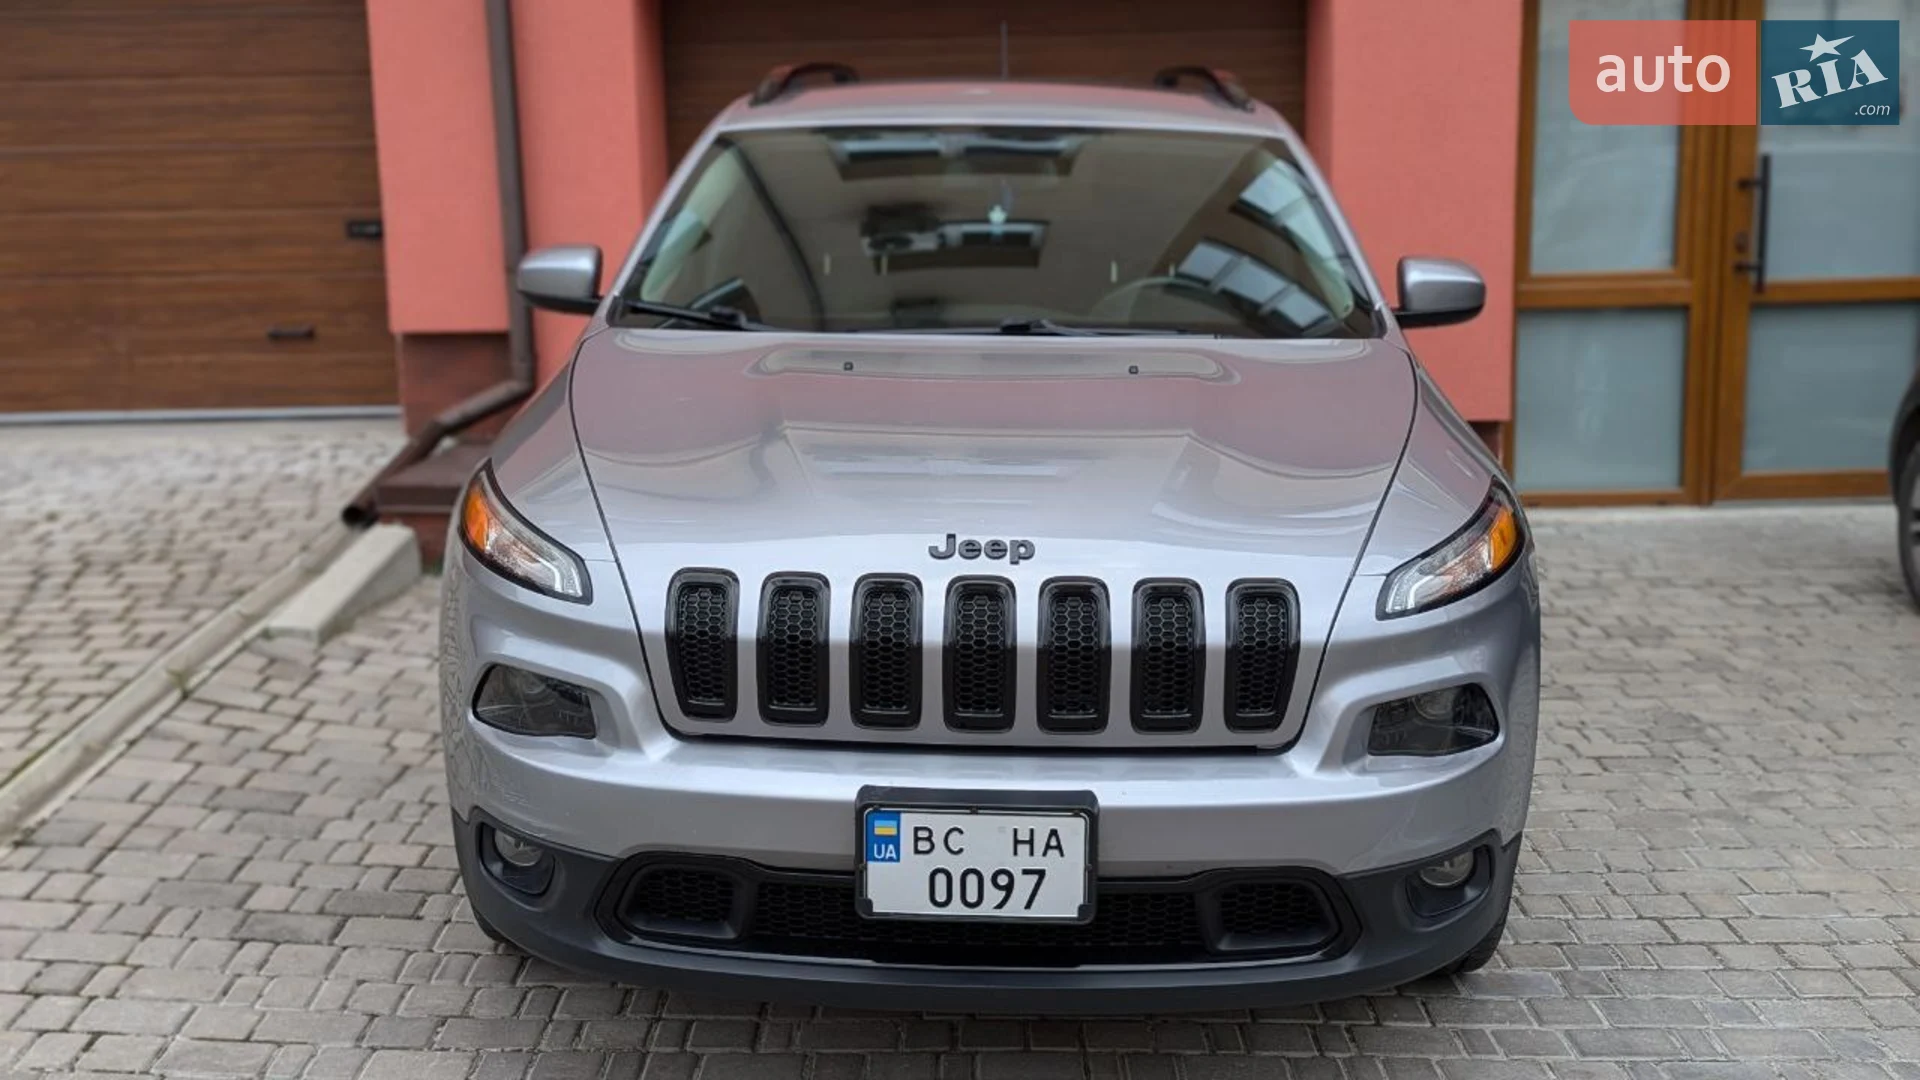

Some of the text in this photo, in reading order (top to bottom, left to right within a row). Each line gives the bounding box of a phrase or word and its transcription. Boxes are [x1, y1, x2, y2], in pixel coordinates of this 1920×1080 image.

[928, 533, 1036, 565] Jeep
[873, 843, 897, 860] UA
[913, 826, 1065, 858] BC HA
[928, 867, 1047, 910] 0097
